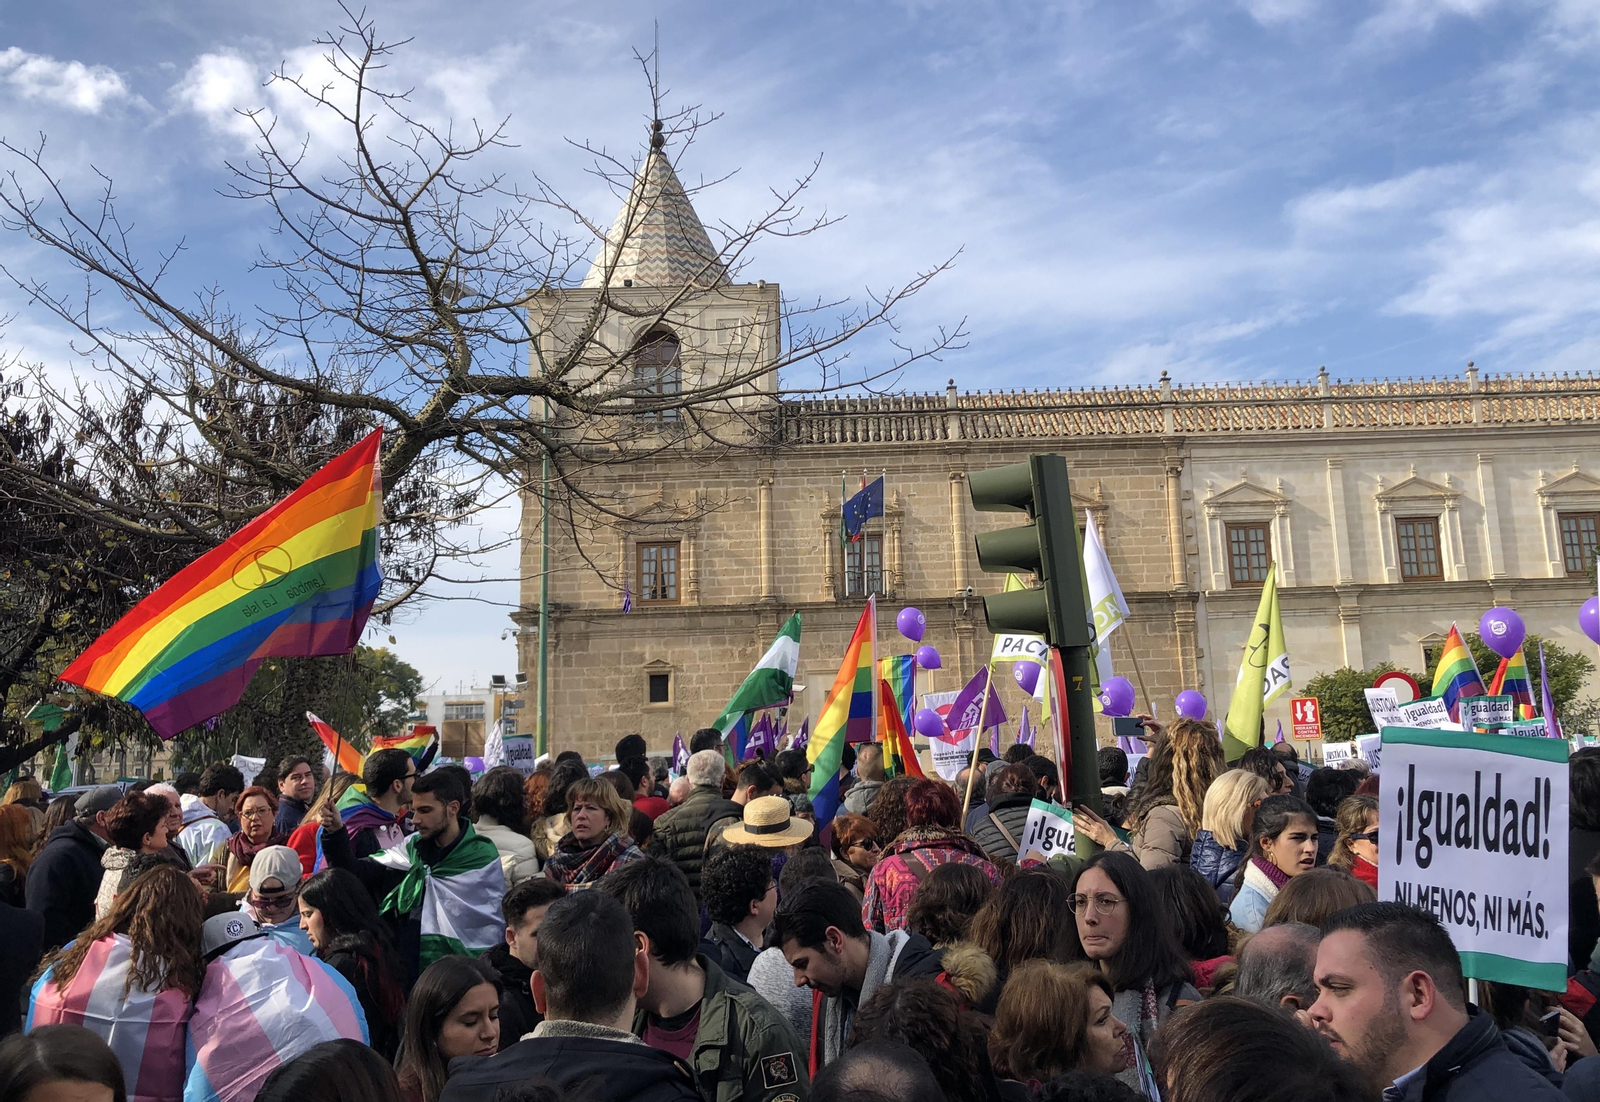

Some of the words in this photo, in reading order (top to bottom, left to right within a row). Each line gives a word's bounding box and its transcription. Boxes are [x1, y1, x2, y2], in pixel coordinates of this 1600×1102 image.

[1072, 676, 1083, 691] 7
[1396, 764, 1551, 869] ¡Igualdad!
[1417, 884, 1480, 936] MENOS,
[1484, 894, 1502, 932] NI
[1507, 890, 1549, 940] MÁS.
